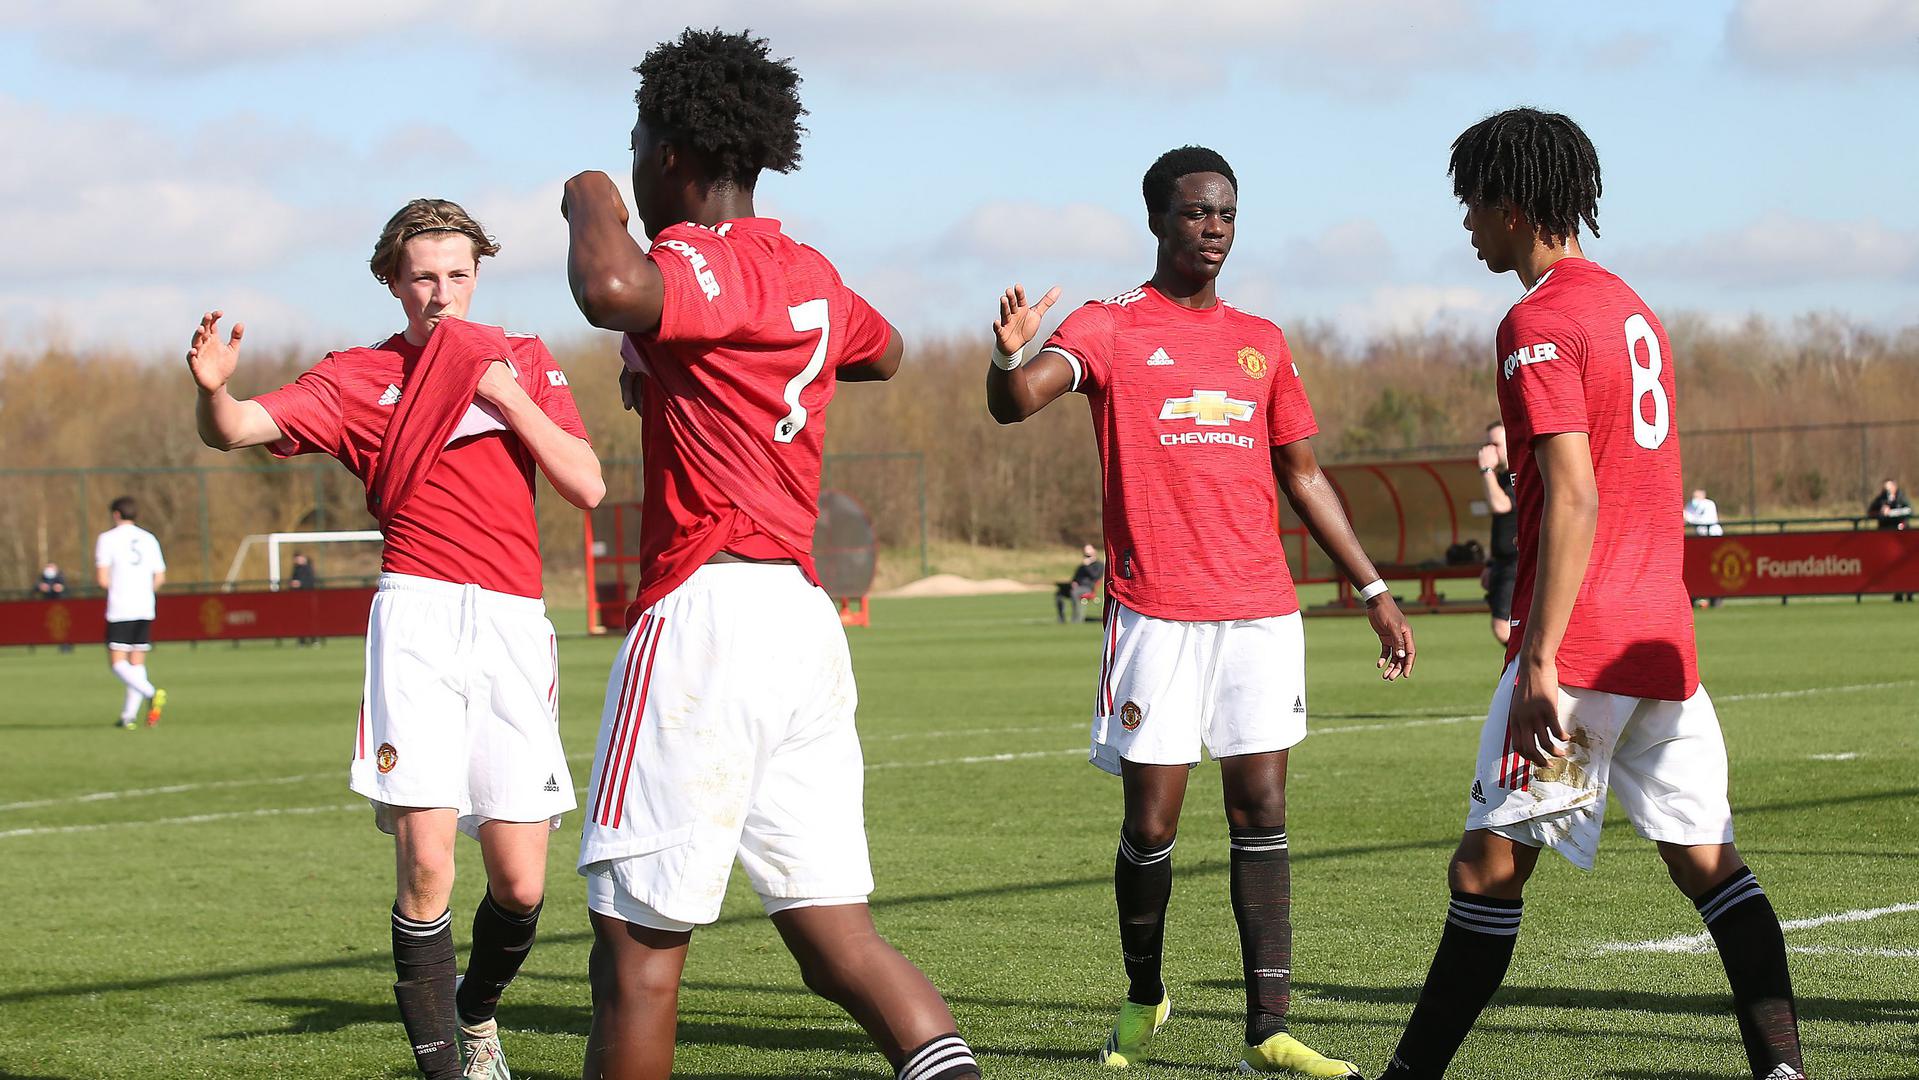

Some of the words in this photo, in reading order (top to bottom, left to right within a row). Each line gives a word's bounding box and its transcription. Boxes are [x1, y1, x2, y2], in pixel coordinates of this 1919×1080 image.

[773, 298, 830, 444] 7
[1504, 342, 1561, 380] KOHLER
[1624, 313, 1670, 450] 8
[1160, 432, 1255, 449] CHEVROLET
[130, 538, 143, 567] 5
[1756, 555, 1862, 578] Foundation
